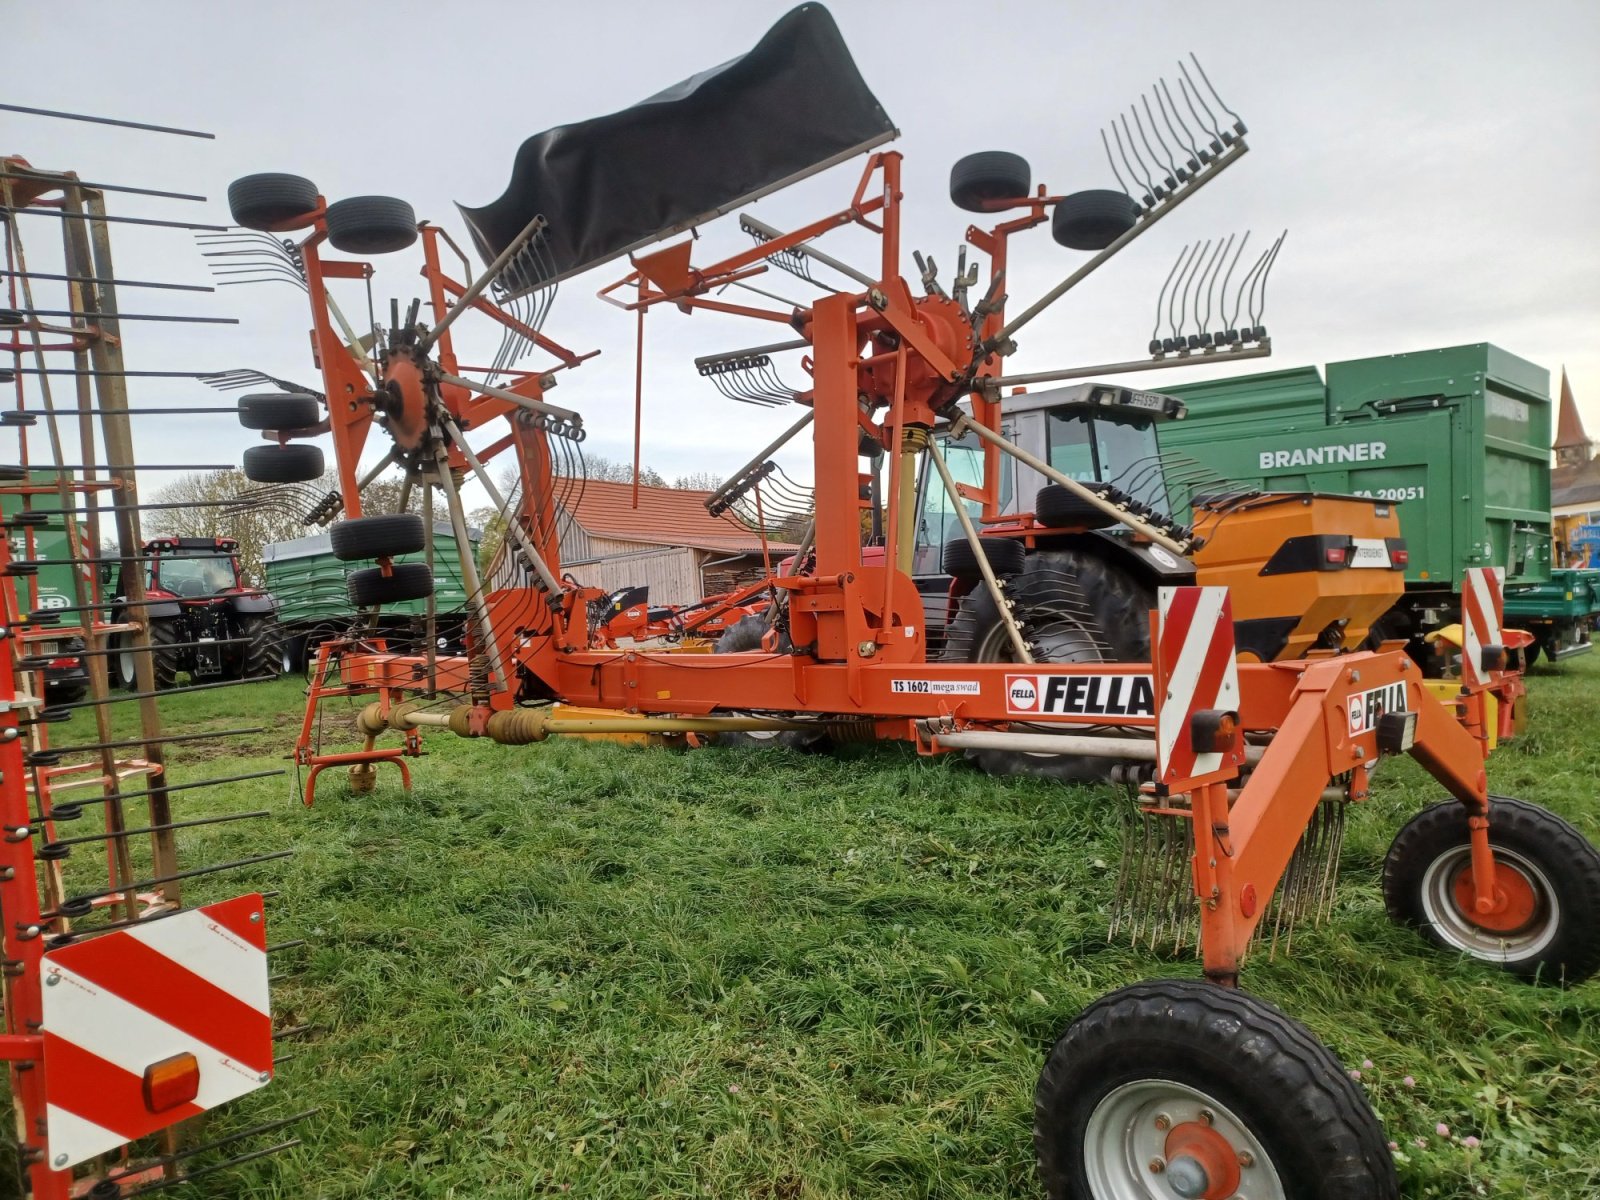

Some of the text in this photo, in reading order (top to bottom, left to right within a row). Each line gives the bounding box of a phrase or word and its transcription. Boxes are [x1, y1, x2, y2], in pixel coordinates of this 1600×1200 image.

[1259, 441, 1387, 469] BRANTNER
[1376, 486, 1425, 500] 20051
[893, 681, 978, 693] TS 1602 mega swad
[1011, 689, 1035, 699] FELLA
[1043, 676, 1156, 715] FELLA
